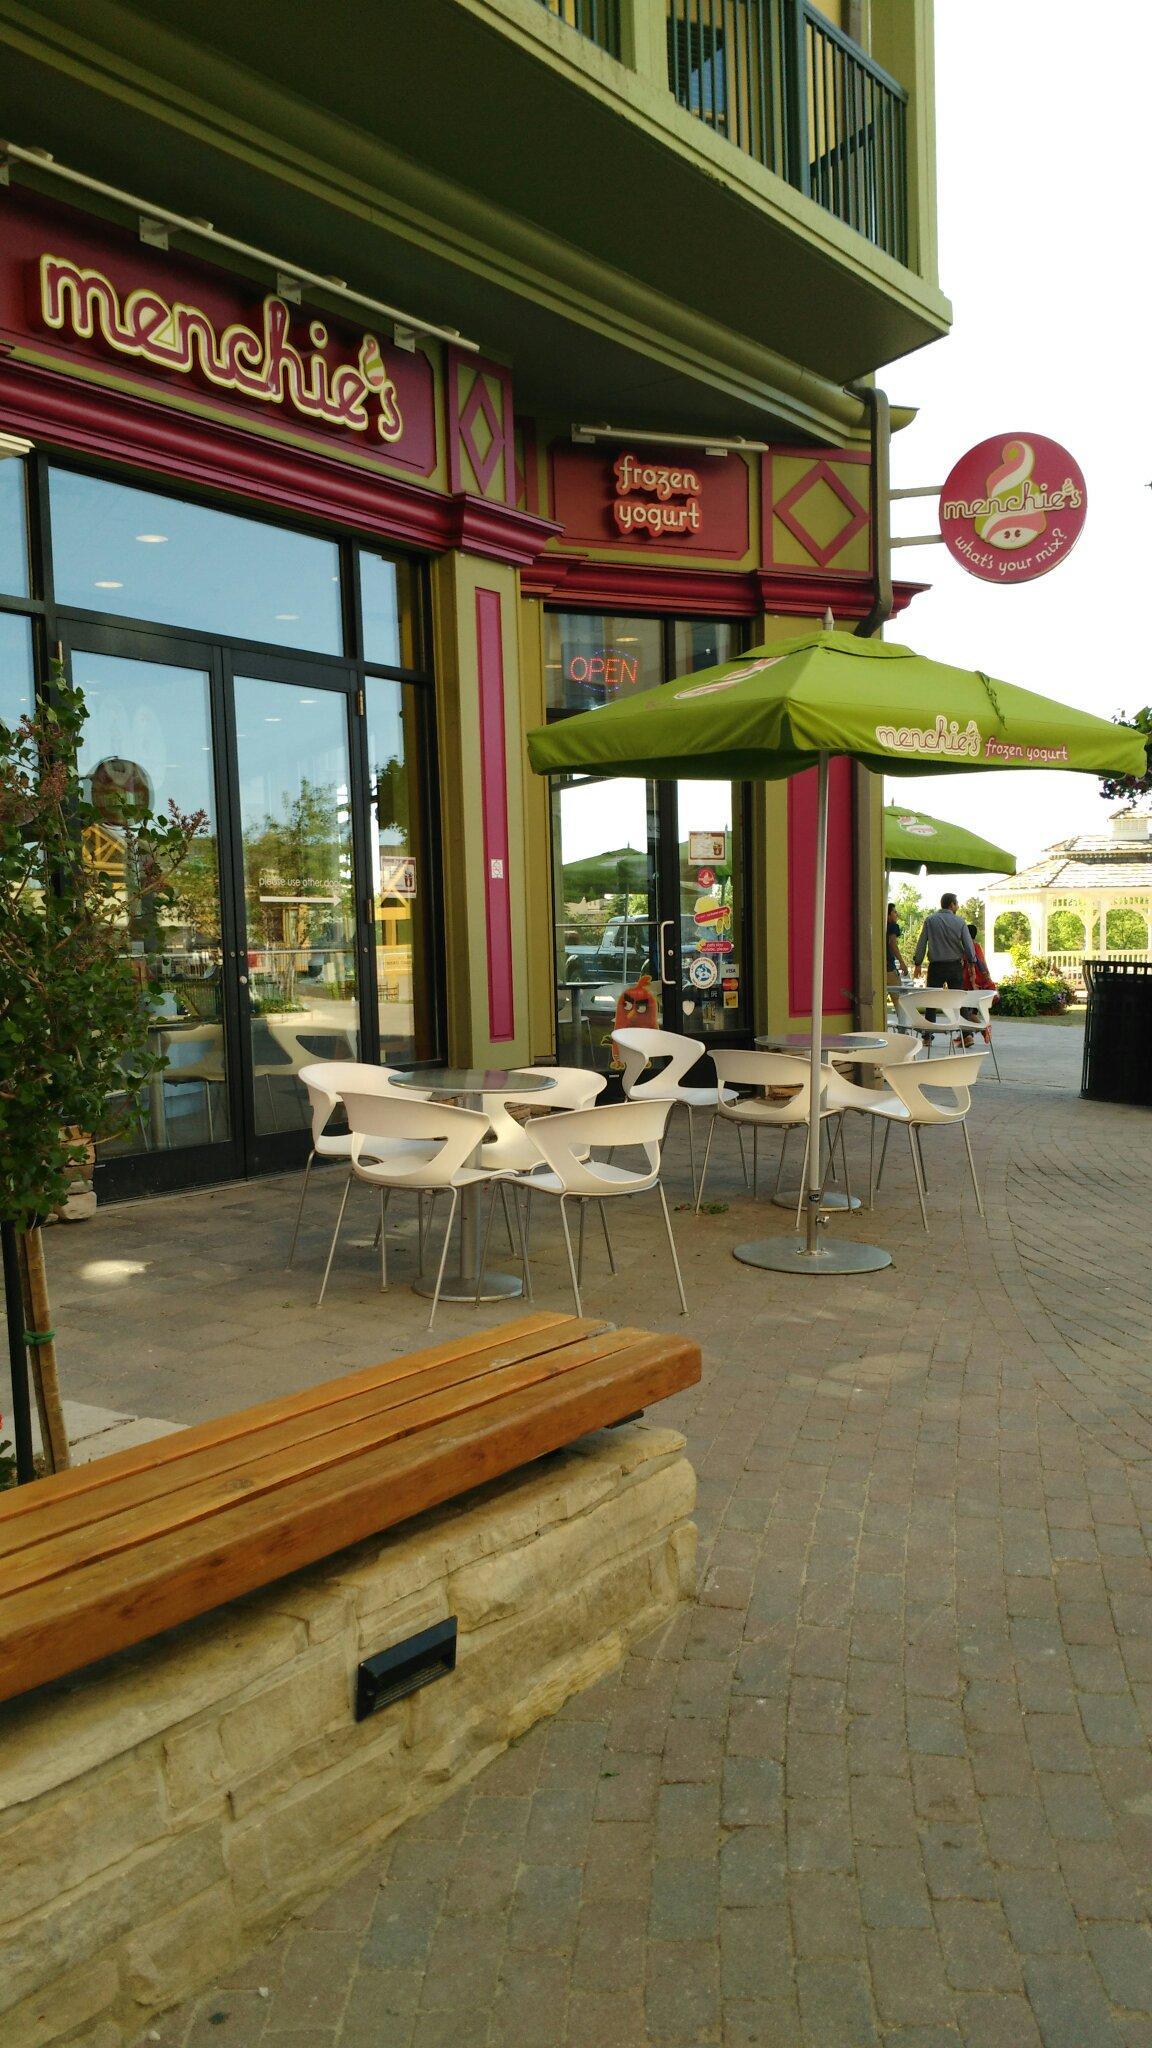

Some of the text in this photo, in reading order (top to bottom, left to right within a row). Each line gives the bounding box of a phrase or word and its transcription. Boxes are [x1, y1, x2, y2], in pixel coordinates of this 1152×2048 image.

[40, 253, 402, 443] menchie's
[619, 455, 699, 495] frozen
[619, 502, 699, 531] yogurt
[943, 478, 1082, 520] menchie's
[955, 528, 1068, 575] what's your mix?
[570, 656, 638, 684] OPEN
[876, 715, 1069, 761] menchie's frozen yogurt
[259, 877, 286, 887] please
[287, 878, 301, 887] use
[302, 878, 322, 887] other
